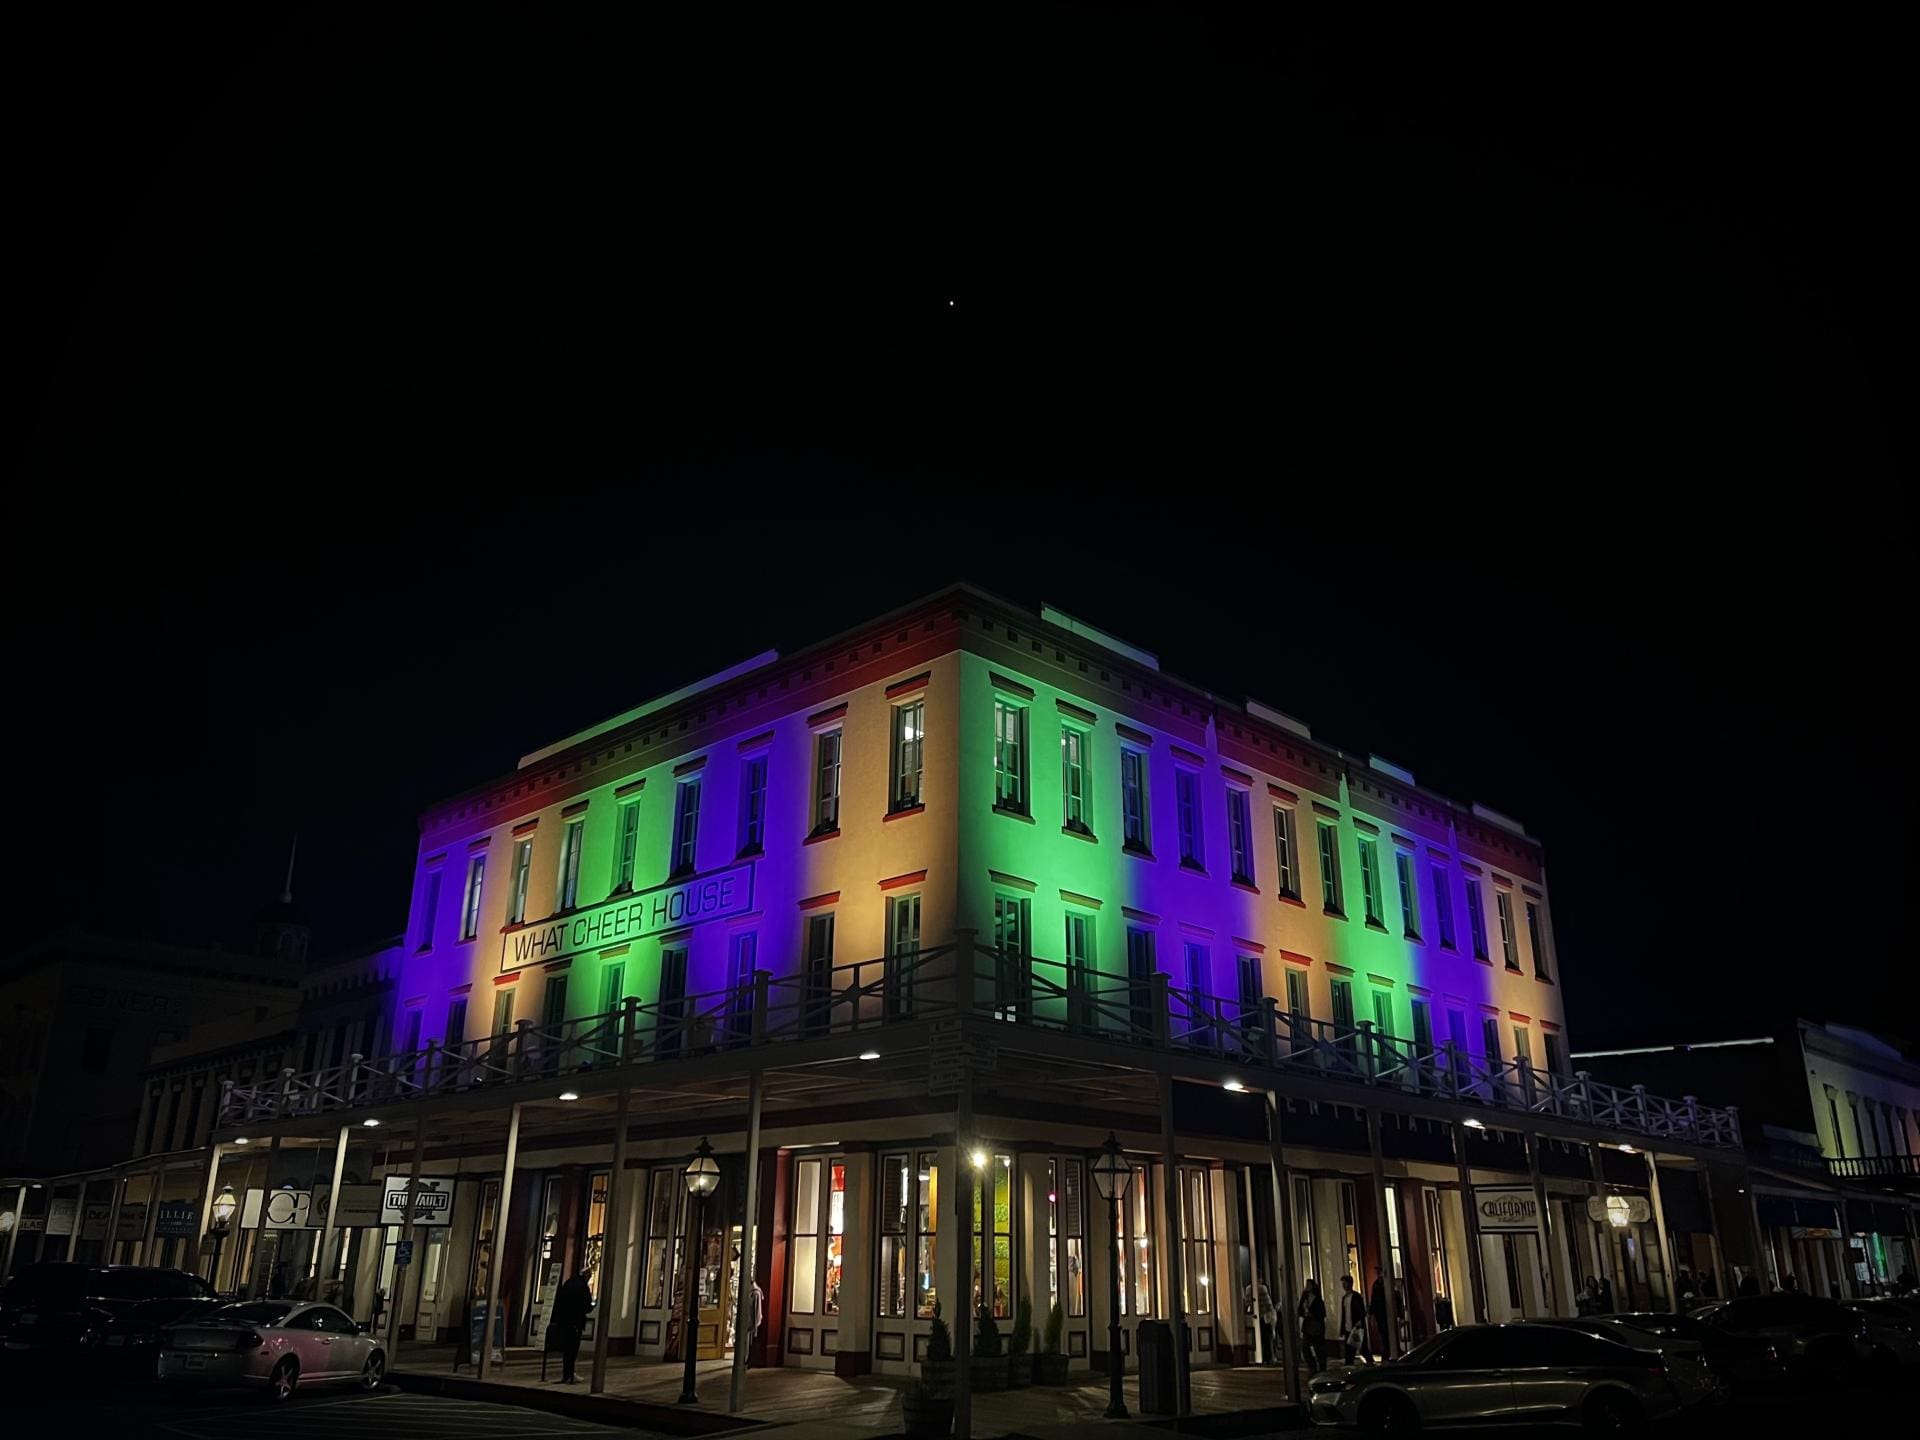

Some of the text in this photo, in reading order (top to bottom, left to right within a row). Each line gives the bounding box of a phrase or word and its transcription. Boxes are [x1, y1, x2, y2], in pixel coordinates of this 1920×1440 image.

[515, 877, 735, 962] WHAT CHEER HOUSE
[391, 1194, 408, 1206] TH
[1482, 1200, 1536, 1217] CALIFORNIA
